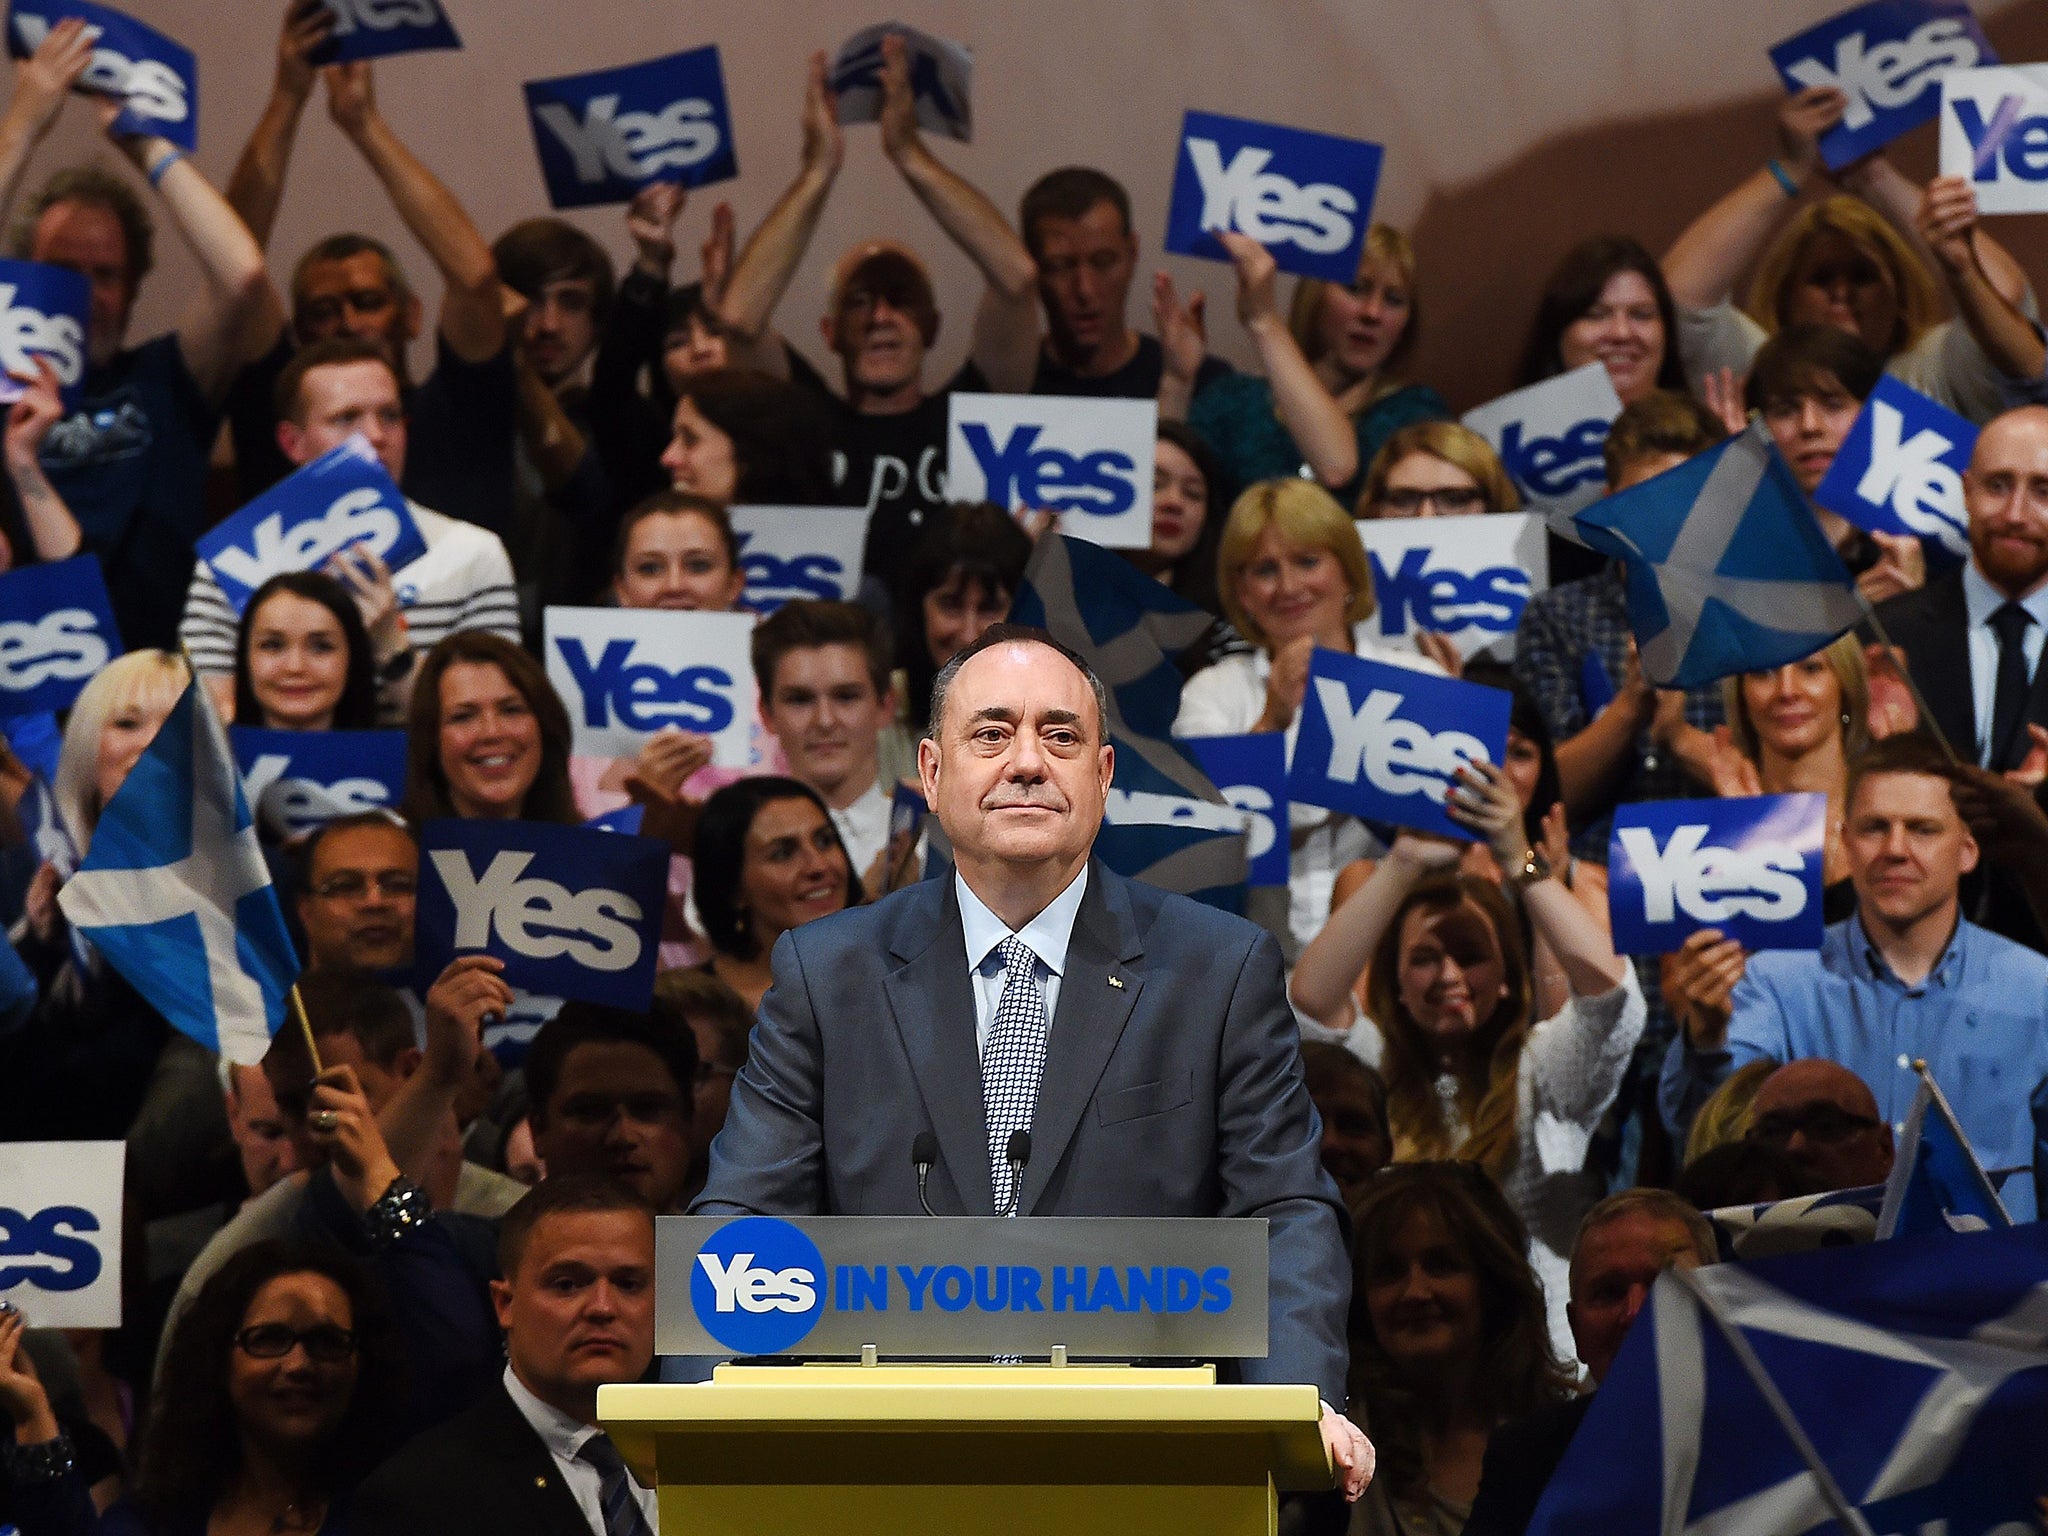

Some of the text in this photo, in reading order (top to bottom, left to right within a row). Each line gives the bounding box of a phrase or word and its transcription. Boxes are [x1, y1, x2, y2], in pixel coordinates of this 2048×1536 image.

[327, 0, 437, 36] es
[1786, 18, 1979, 130] Yes
[539, 93, 721, 183] Yes
[1186, 137, 1357, 254] Yes
[0, 283, 84, 386] es
[959, 423, 1136, 515] Yes
[1857, 398, 1974, 560] Ye
[212, 487, 400, 588] Yes
[736, 531, 843, 614] es
[1372, 548, 1531, 636] Yes
[556, 638, 733, 733] Yes
[1315, 677, 1491, 802] Yes
[429, 849, 642, 971] Yes
[1617, 824, 1806, 923] Yes
[696, 1253, 1233, 1313] Yes IN YOUR HANDS
